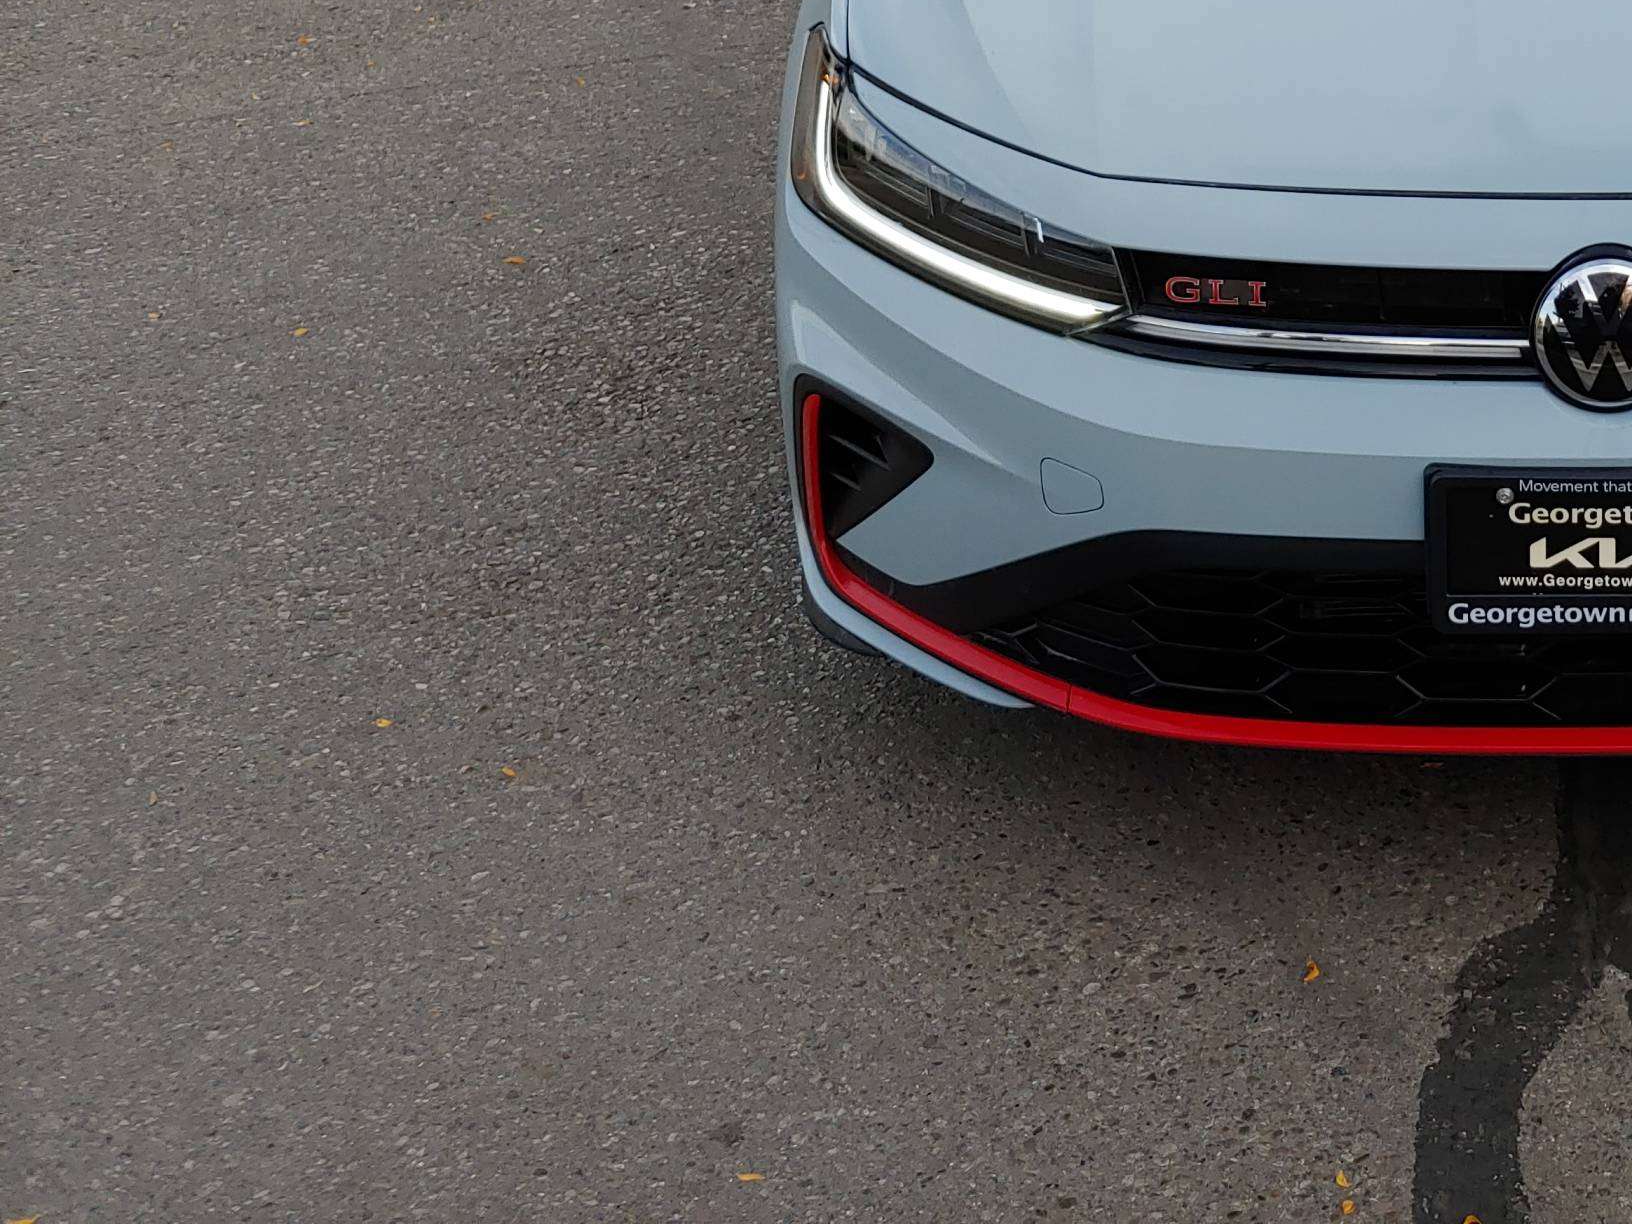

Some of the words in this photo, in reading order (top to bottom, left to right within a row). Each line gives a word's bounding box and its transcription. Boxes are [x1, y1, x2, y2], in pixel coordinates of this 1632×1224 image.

[1165, 275, 1267, 308] GLI
[1519, 479, 1599, 493] Movement
[1602, 479, 1632, 493] that
